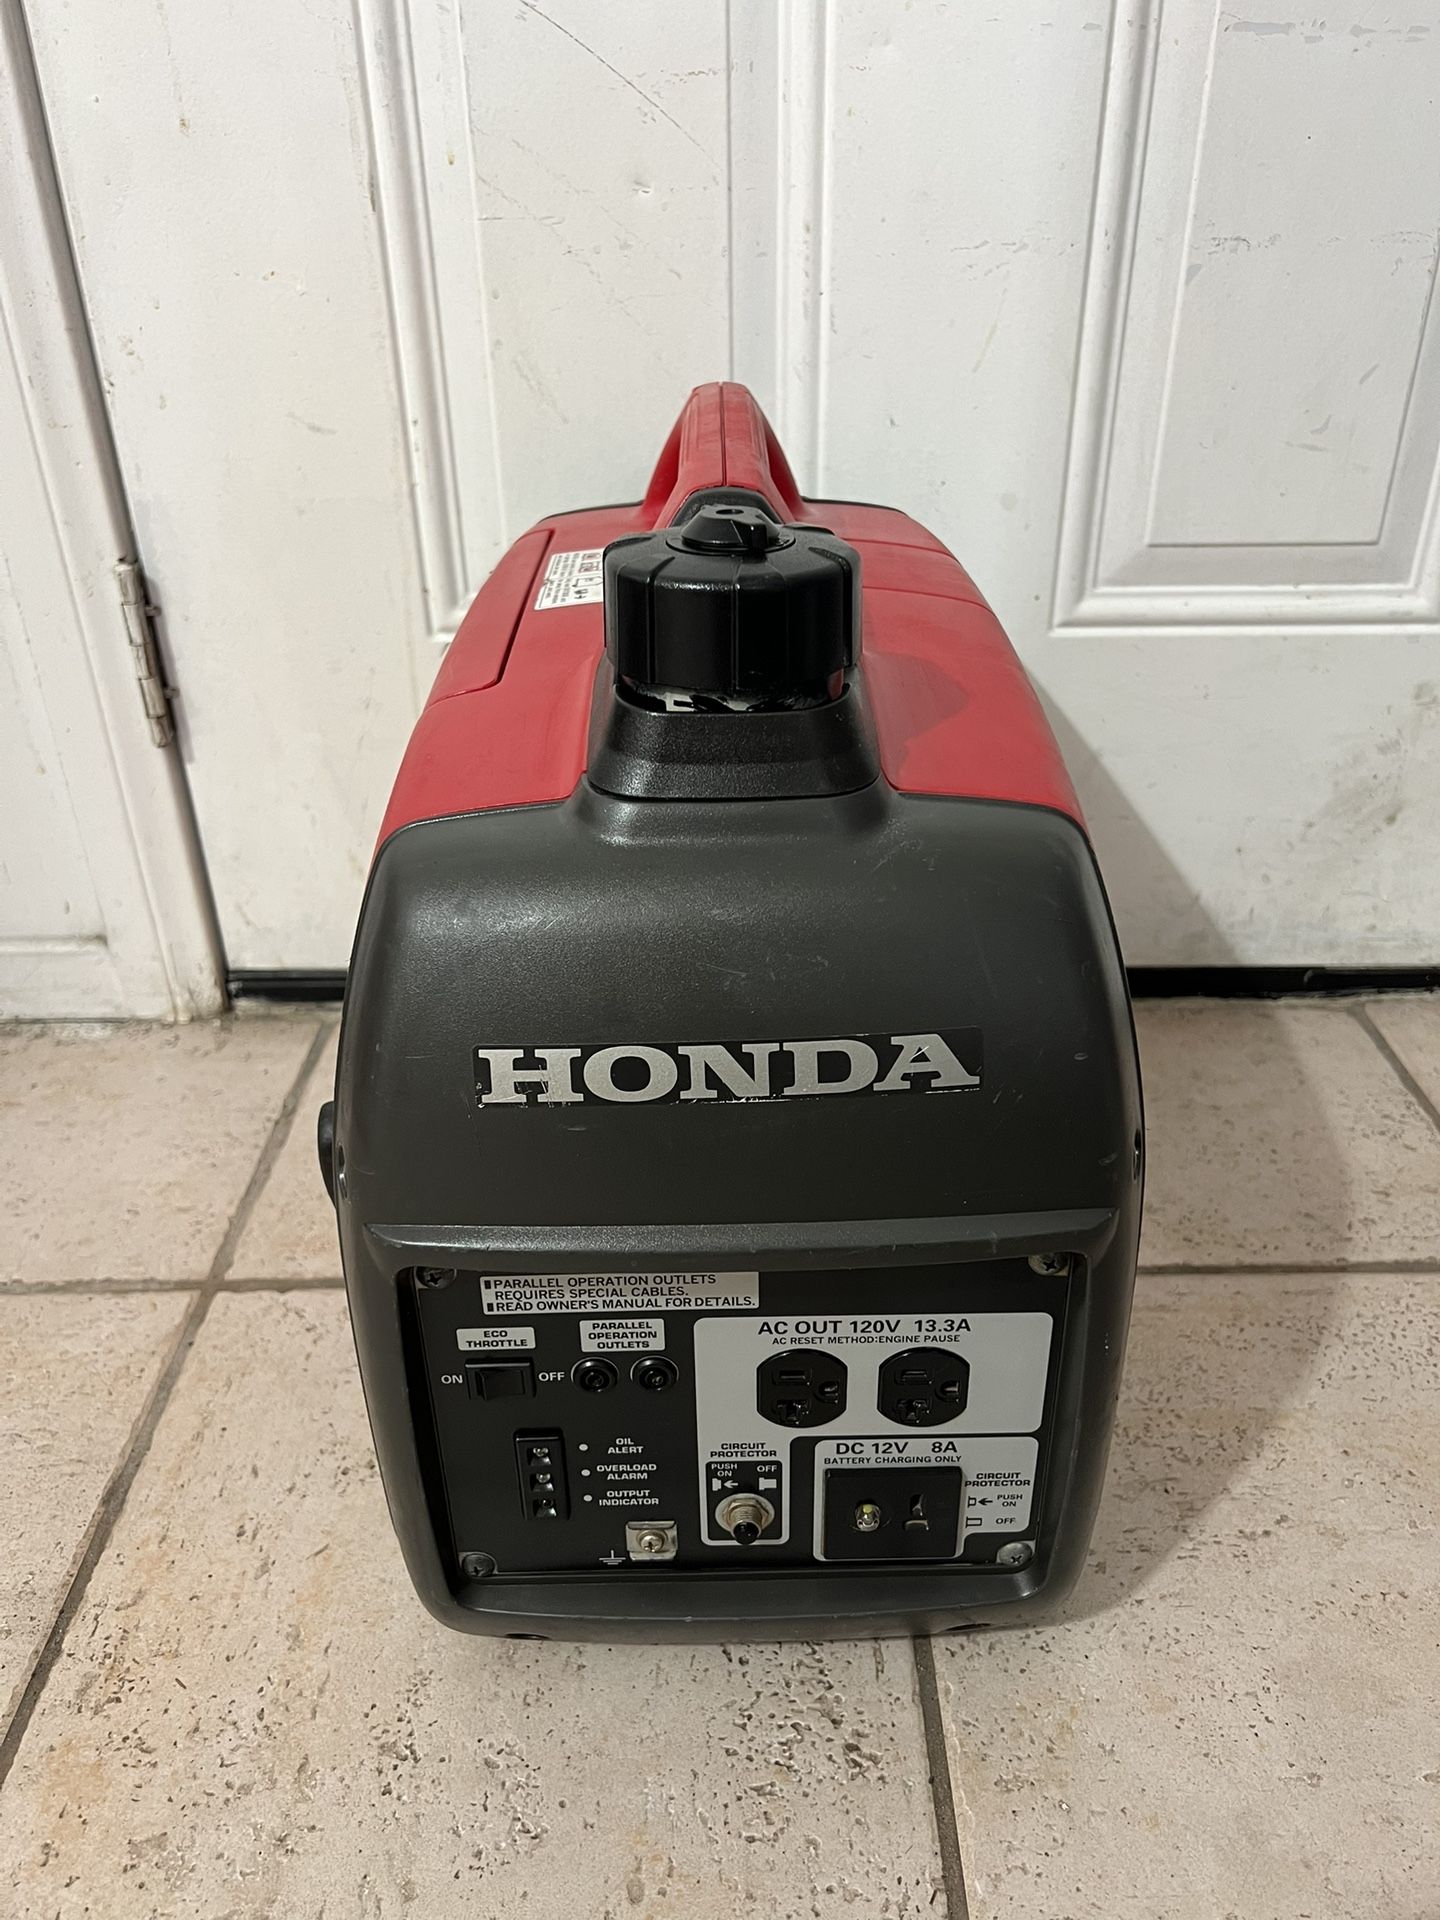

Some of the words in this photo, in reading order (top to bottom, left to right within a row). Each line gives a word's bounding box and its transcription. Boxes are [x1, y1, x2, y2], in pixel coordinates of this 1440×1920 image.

[477, 1033, 980, 1103] HONDA
[493, 1278, 564, 1289] PARALLEL
[568, 1276, 649, 1287] OPERATION
[652, 1274, 717, 1285] OUTLETS
[495, 1289, 565, 1301] REQUIRES
[569, 1288, 627, 1299] SPECIAL
[631, 1286, 689, 1297] CABLES.
[496, 1301, 533, 1312] READ
[536, 1300, 599, 1310] OWNER'S
[602, 1298, 662, 1309] MANUAL
[665, 1297, 692, 1307] FOR
[694, 1296, 756, 1307] DETAILS.
[592, 1322, 653, 1330] PARALLEL
[757, 1321, 789, 1335] AC
[794, 1320, 843, 1334] OUT
[849, 1319, 902, 1334] 120V
[914, 1318, 972, 1333] 13.3A
[483, 1330, 508, 1338] ECO
[588, 1331, 657, 1340] OPERATION
[466, 1339, 528, 1348] THROTTLE
[772, 1336, 788, 1345] AC
[790, 1336, 825, 1345] RESET
[923, 1334, 961, 1343] PAUSE
[597, 1340, 650, 1349] OUTLETS
[441, 1374, 464, 1384] ON
[538, 1372, 565, 1382] OFF
[615, 1437, 634, 1446] OIL
[720, 1442, 767, 1450] CIRCUIT
[607, 1446, 644, 1454] ALERT
[835, 1443, 865, 1455] DC
[871, 1442, 909, 1454] 12V
[931, 1441, 958, 1453] 8A
[710, 1450, 777, 1458] PROTECTOR
[824, 1457, 872, 1465] BATTERY
[874, 1456, 932, 1464] CHARGING
[934, 1455, 962, 1463] ONLY
[596, 1463, 657, 1472] OVERLOAD
[756, 1465, 778, 1473] OFF
[606, 1472, 648, 1480] ALARM
[976, 1472, 1021, 1480] CIRCUIT
[964, 1479, 1031, 1487] PROTECTOR
[606, 1489, 651, 1498] OUTPUT
[997, 1493, 1023, 1501] PUSH
[599, 1498, 659, 1506] INDICATOR
[1002, 1500, 1017, 1508] ON
[995, 1517, 1016, 1525] OFF
